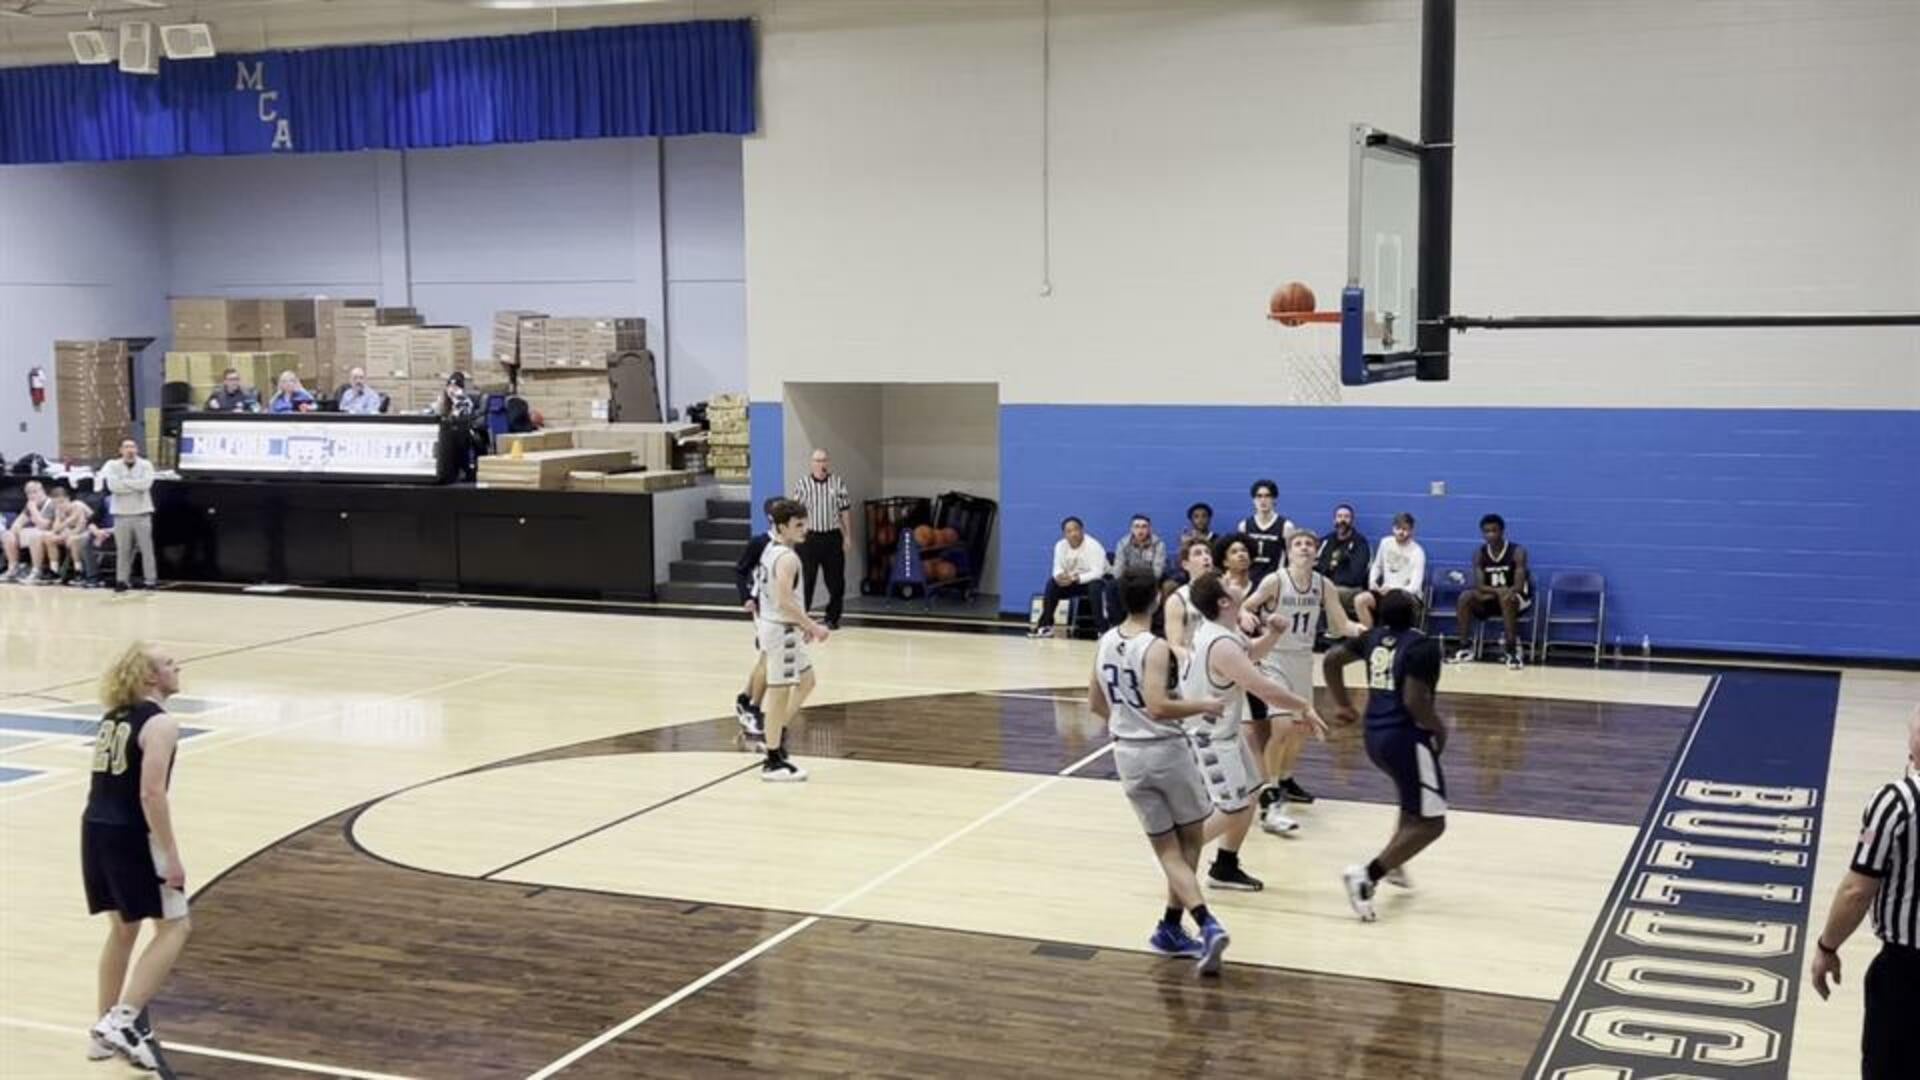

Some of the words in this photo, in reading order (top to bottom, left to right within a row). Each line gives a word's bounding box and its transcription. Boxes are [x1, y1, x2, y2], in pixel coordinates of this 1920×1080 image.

[1291, 611, 1310, 634] 11
[1102, 663, 1147, 709] 23
[93, 719, 131, 775] 20
[1552, 778, 1818, 1080] BULLDOG
